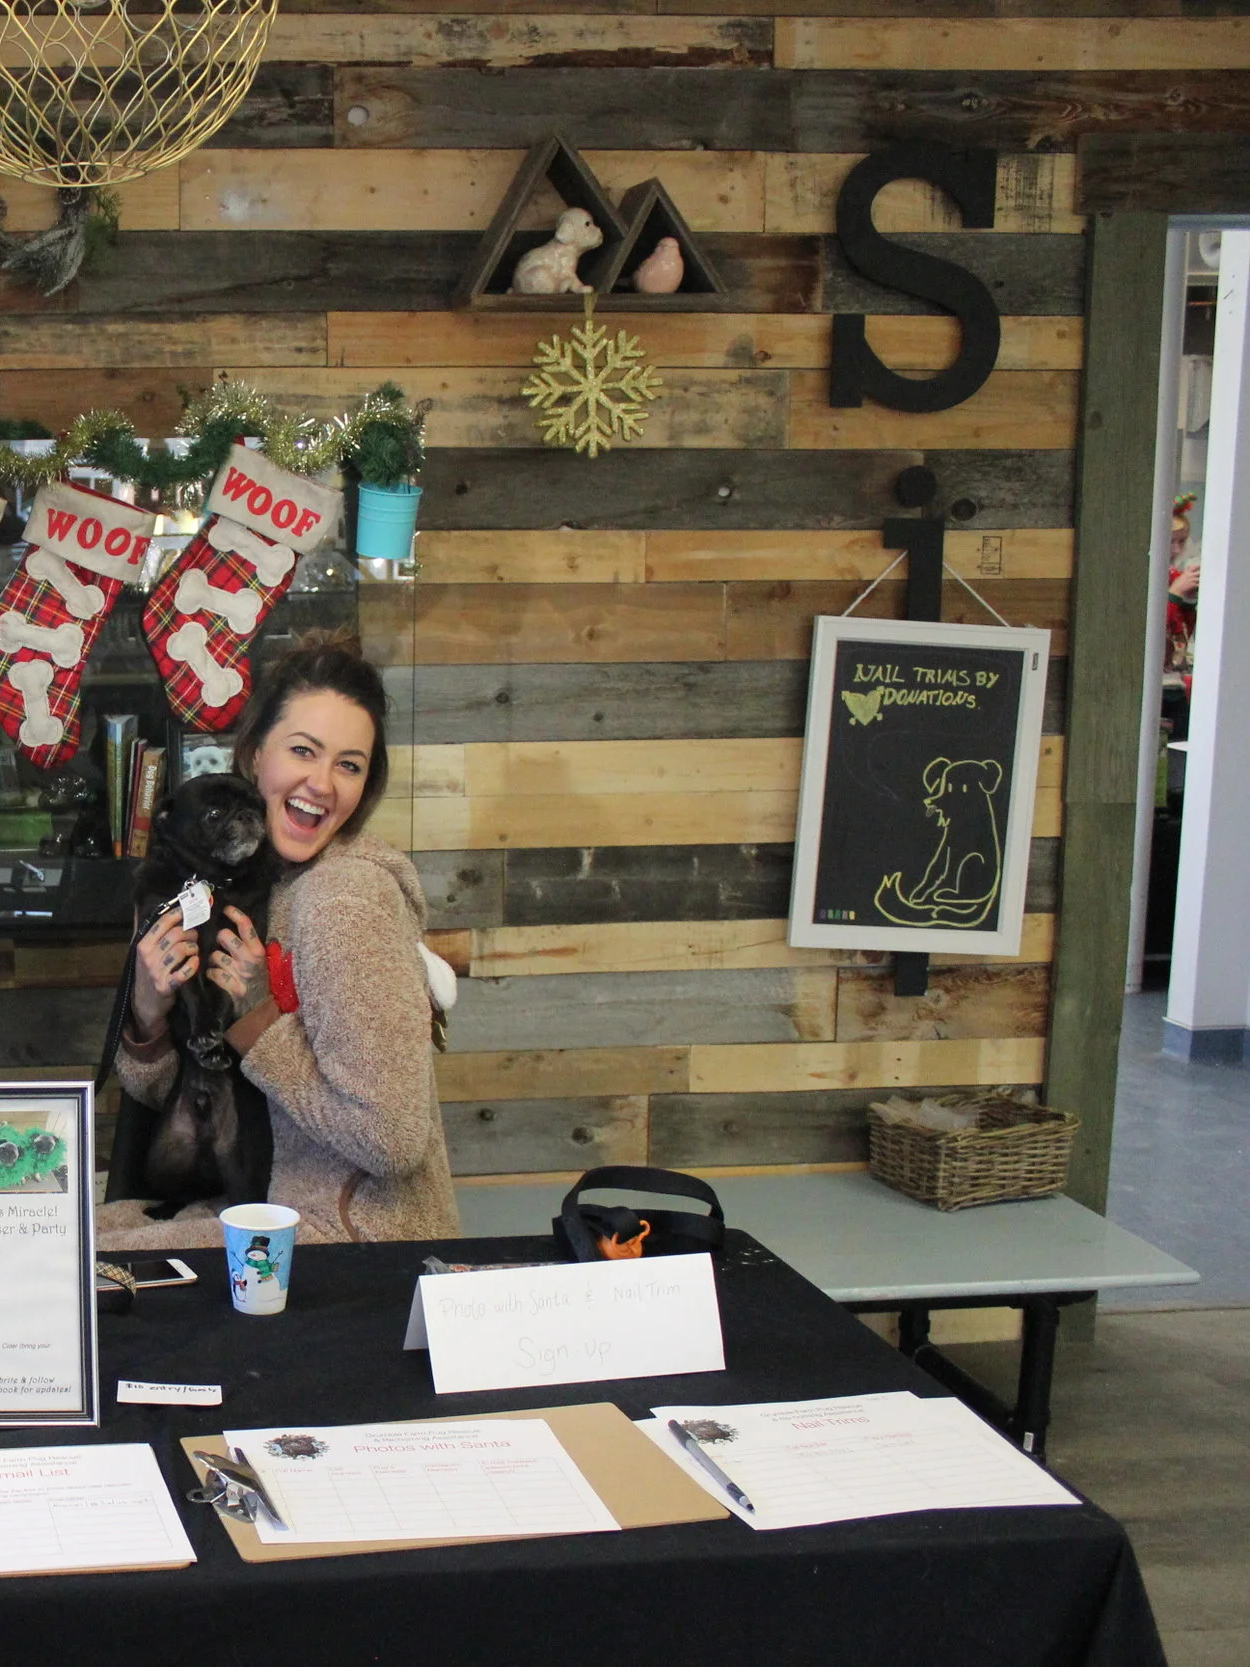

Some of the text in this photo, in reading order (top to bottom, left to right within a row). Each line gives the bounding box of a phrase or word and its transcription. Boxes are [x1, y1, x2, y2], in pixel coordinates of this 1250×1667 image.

[221, 466, 321, 538] WOOF
[46, 507, 150, 566] WOOF
[853, 663, 1000, 688] NAIL TRIMS BY
[7, 1205, 58, 1217] Miracle!
[18, 1223, 28, 1234] &
[32, 1223, 67, 1237] Party
[529, 1288, 571, 1316] Santa
[614, 1284, 642, 1303] Nail
[645, 1281, 681, 1299] Trim
[29, 1376, 55, 1385] follow
[20, 1386, 33, 1395] for
[792, 1415, 870, 1431] Nail Trims
[353, 1440, 511, 1454] Photos with Santa
[39, 1467, 71, 1478] List
